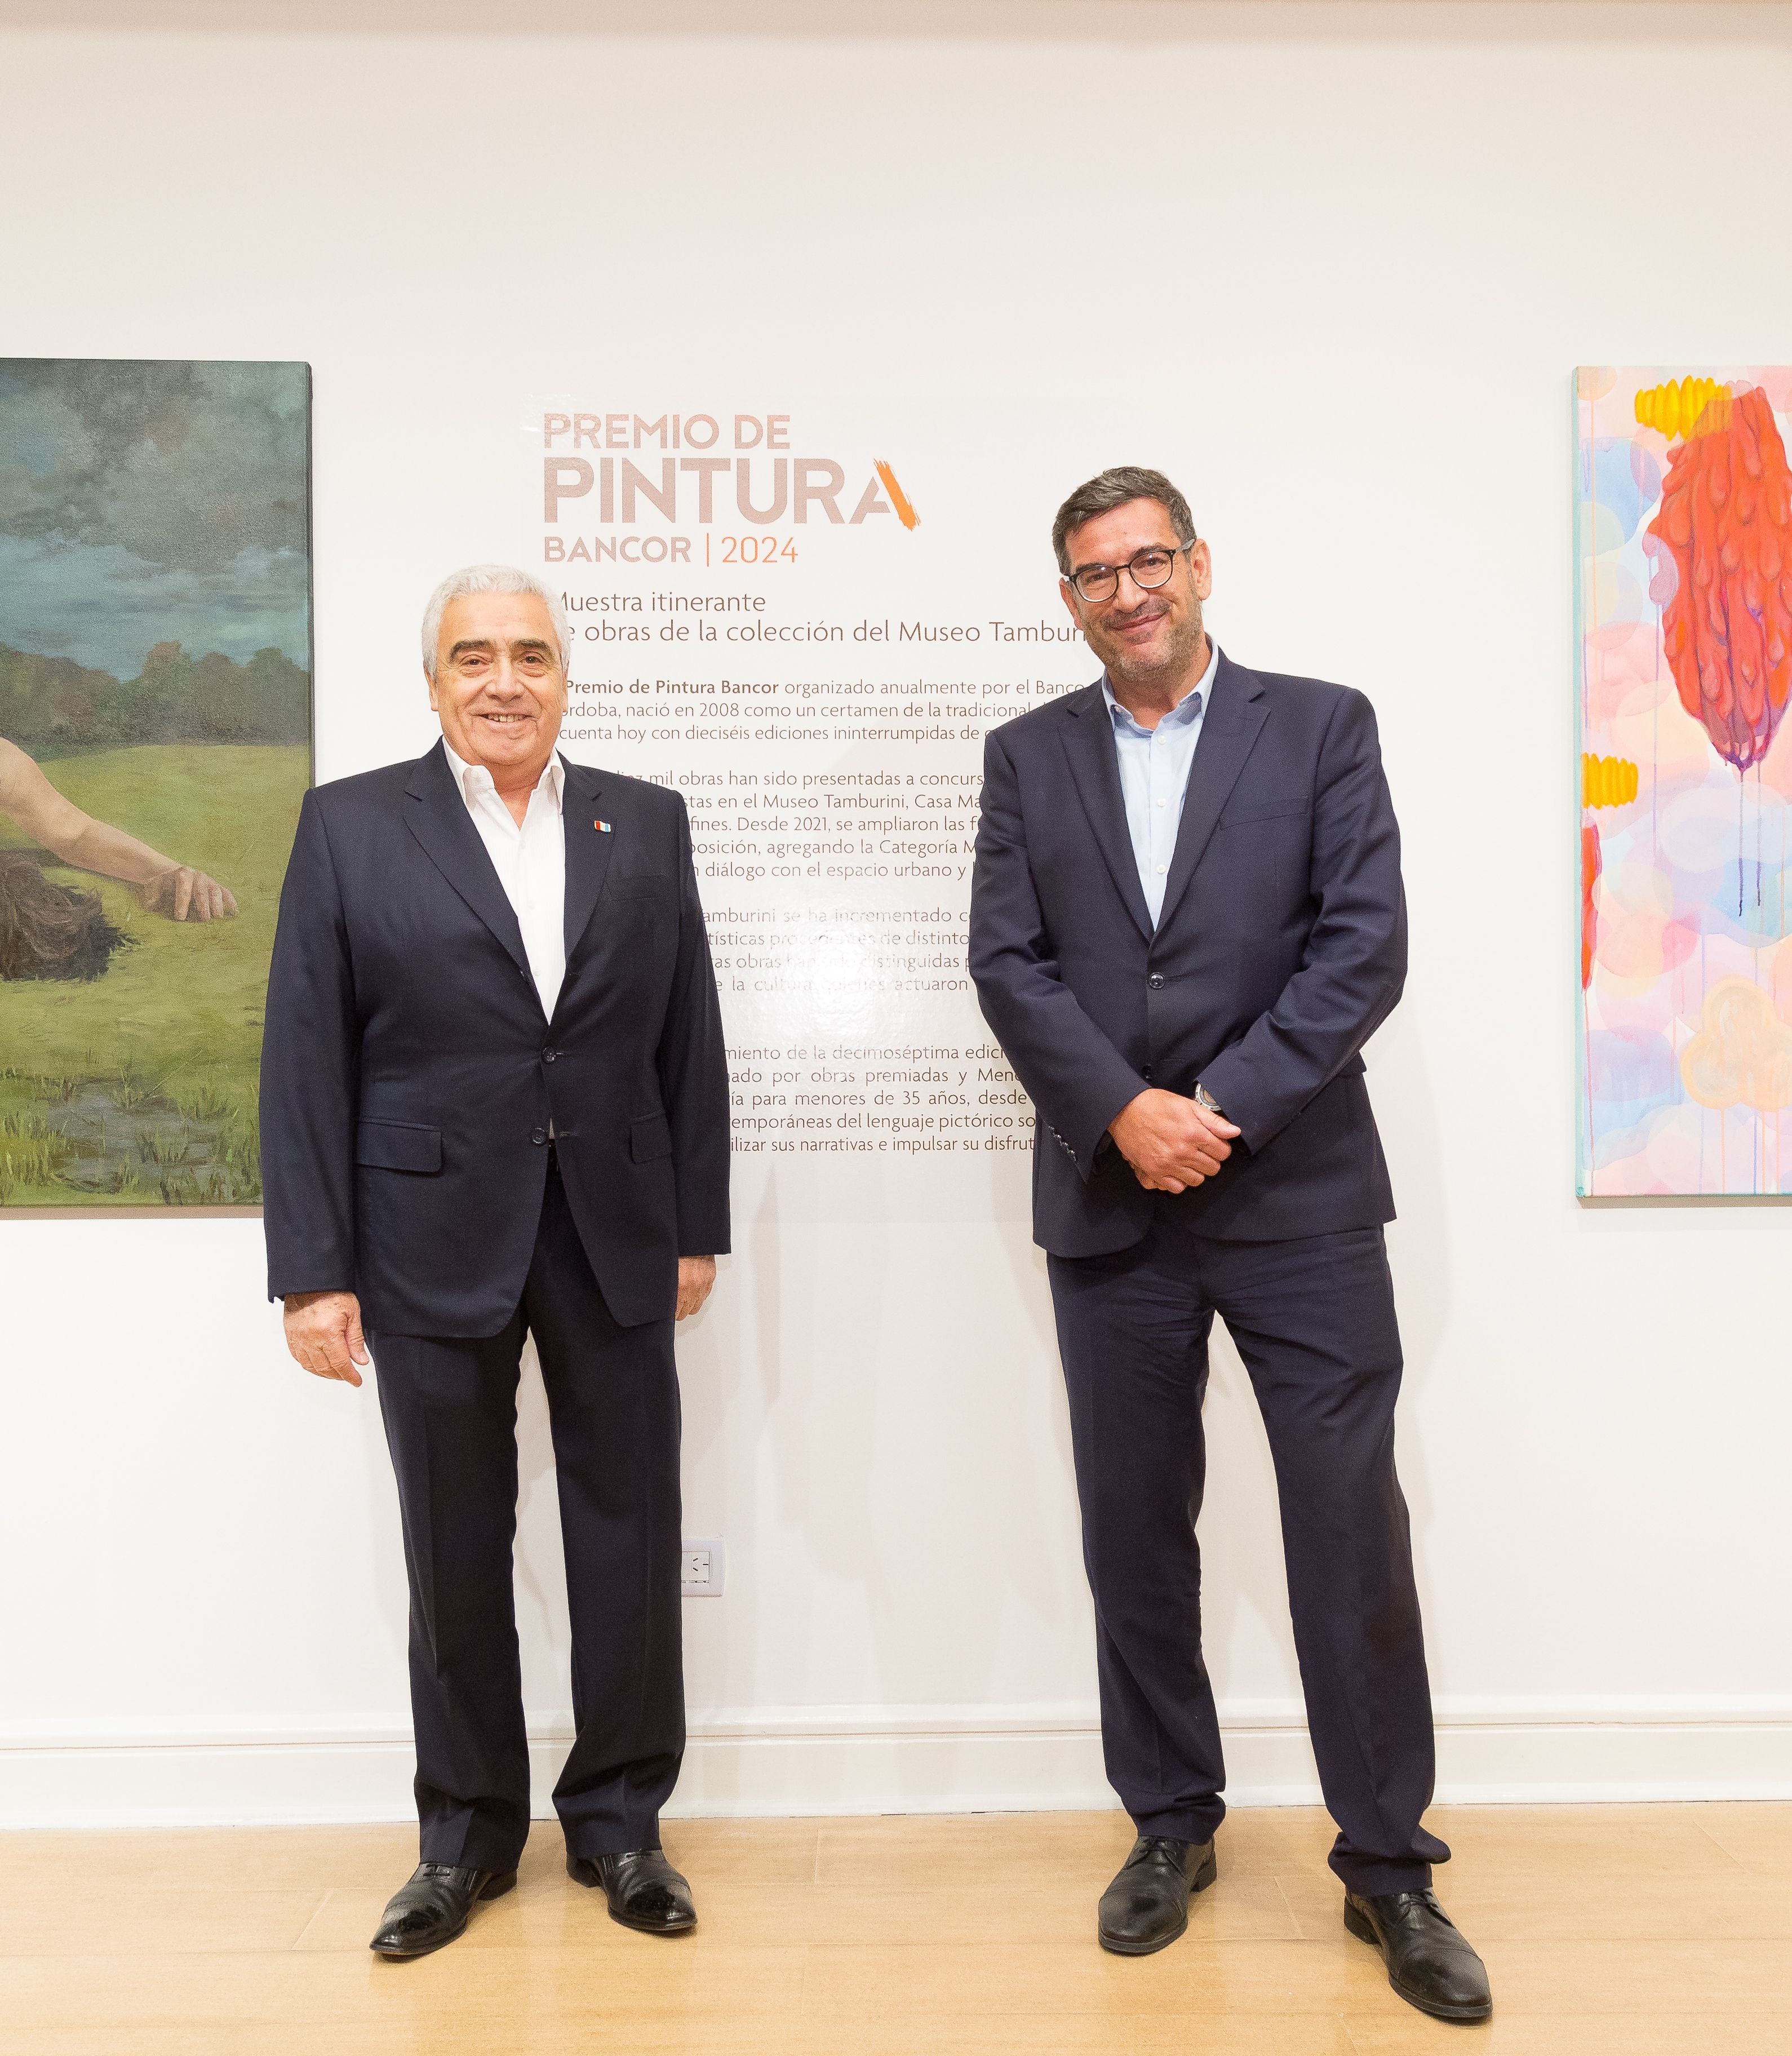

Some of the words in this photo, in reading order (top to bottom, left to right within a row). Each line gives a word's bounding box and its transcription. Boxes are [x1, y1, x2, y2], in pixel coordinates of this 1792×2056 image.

[544, 414, 719, 449] PREMIO
[735, 415, 789, 449] DE
[544, 458, 920, 531] PINTURA
[544, 537, 691, 562] BANCOR
[722, 537, 798, 562] 2024
[652, 591, 765, 612] itinerante
[585, 619, 650, 641] obras
[660, 619, 689, 641] de
[700, 619, 717, 641] la
[727, 619, 842, 641] colección
[854, 619, 889, 641] del
[900, 622, 980, 641] Museo
[629, 679, 649, 693] de
[657, 680, 715, 694] Pintura
[722, 680, 779, 694] Bancor
[785, 679, 874, 698] organizado
[880, 679, 976, 694] anualmente
[983, 684, 1010, 698] por
[1017, 679, 1029, 694] el
[627, 702, 669, 716] nació
[675, 706, 694, 717] en
[700, 703, 739, 716] 2008
[744, 707, 791, 716] como
[797, 707, 815, 717] un
[821, 704, 898, 716] certamen
[903, 702, 923, 716] de
[929, 702, 941, 716] la
[946, 702, 1031, 716] tradicional
[560, 726, 612, 739] cuenta
[618, 724, 646, 743] hoy
[652, 729, 680, 739] con
[686, 724, 749, 739] dieciséis
[755, 724, 828, 739] ediciones
[835, 724, 955, 744] ininterrumpidas
[960, 724, 979, 739] de
[650, 770, 673, 785] mil
[680, 770, 723, 785] obras
[729, 770, 757, 785] han
[764, 770, 797, 785] sido
[804, 770, 900, 790] presentadas
[907, 776, 914, 785] a
[718, 798, 737, 808] en
[744, 793, 757, 808] el
[764, 795, 818, 808] Museo
[824, 793, 908, 810] Tamburini,
[915, 795, 952, 808] Casa
[738, 816, 788, 831] Desde
[794, 817, 830, 833] 2021,
[836, 821, 852, 831] se
[858, 816, 938, 835] ampliaron
[944, 816, 964, 831] las
[768, 839, 854, 858] agregando
[861, 839, 873, 853] la
[880, 839, 957, 858] Categoría
[706, 862, 765, 881] diálogo
[771, 867, 800, 876] con
[808, 861, 820, 876] el
[827, 863, 888, 881] espacio
[895, 861, 951, 876] urbano
[957, 866, 966, 881] y
[703, 907, 775, 923] amburini
[783, 912, 800, 923] se
[809, 907, 827, 923] ha
[835, 907, 952, 923] incrementado
[881, 930, 901, 945] de
[736, 953, 781, 968] obras
[733, 976, 744, 991] la
[894, 979, 968, 991] actuaron
[787, 1044, 808, 1060] de
[814, 1045, 826, 1060] la
[833, 1044, 959, 1064] decimoséptima
[773, 1072, 801, 1087] por
[811, 1067, 855, 1082] obras
[866, 1067, 948, 1087] premiadas
[959, 1072, 967, 1086] y
[752, 1095, 787, 1110] para
[795, 1095, 866, 1105] menores
[875, 1089, 894, 1105] de
[903, 1091, 920, 1105] 35
[929, 1091, 970, 1107] años,
[978, 1089, 1027, 1105] desde
[837, 1113, 862, 1128] del
[867, 1113, 934, 1133] lenguaje
[939, 1113, 1013, 1132] pictórico
[771, 1140, 795, 1151] sus
[800, 1137, 874, 1151] narrativas
[879, 1141, 888, 1151] e
[893, 1136, 957, 1155] impulsar
[963, 1140, 979, 1151] su
